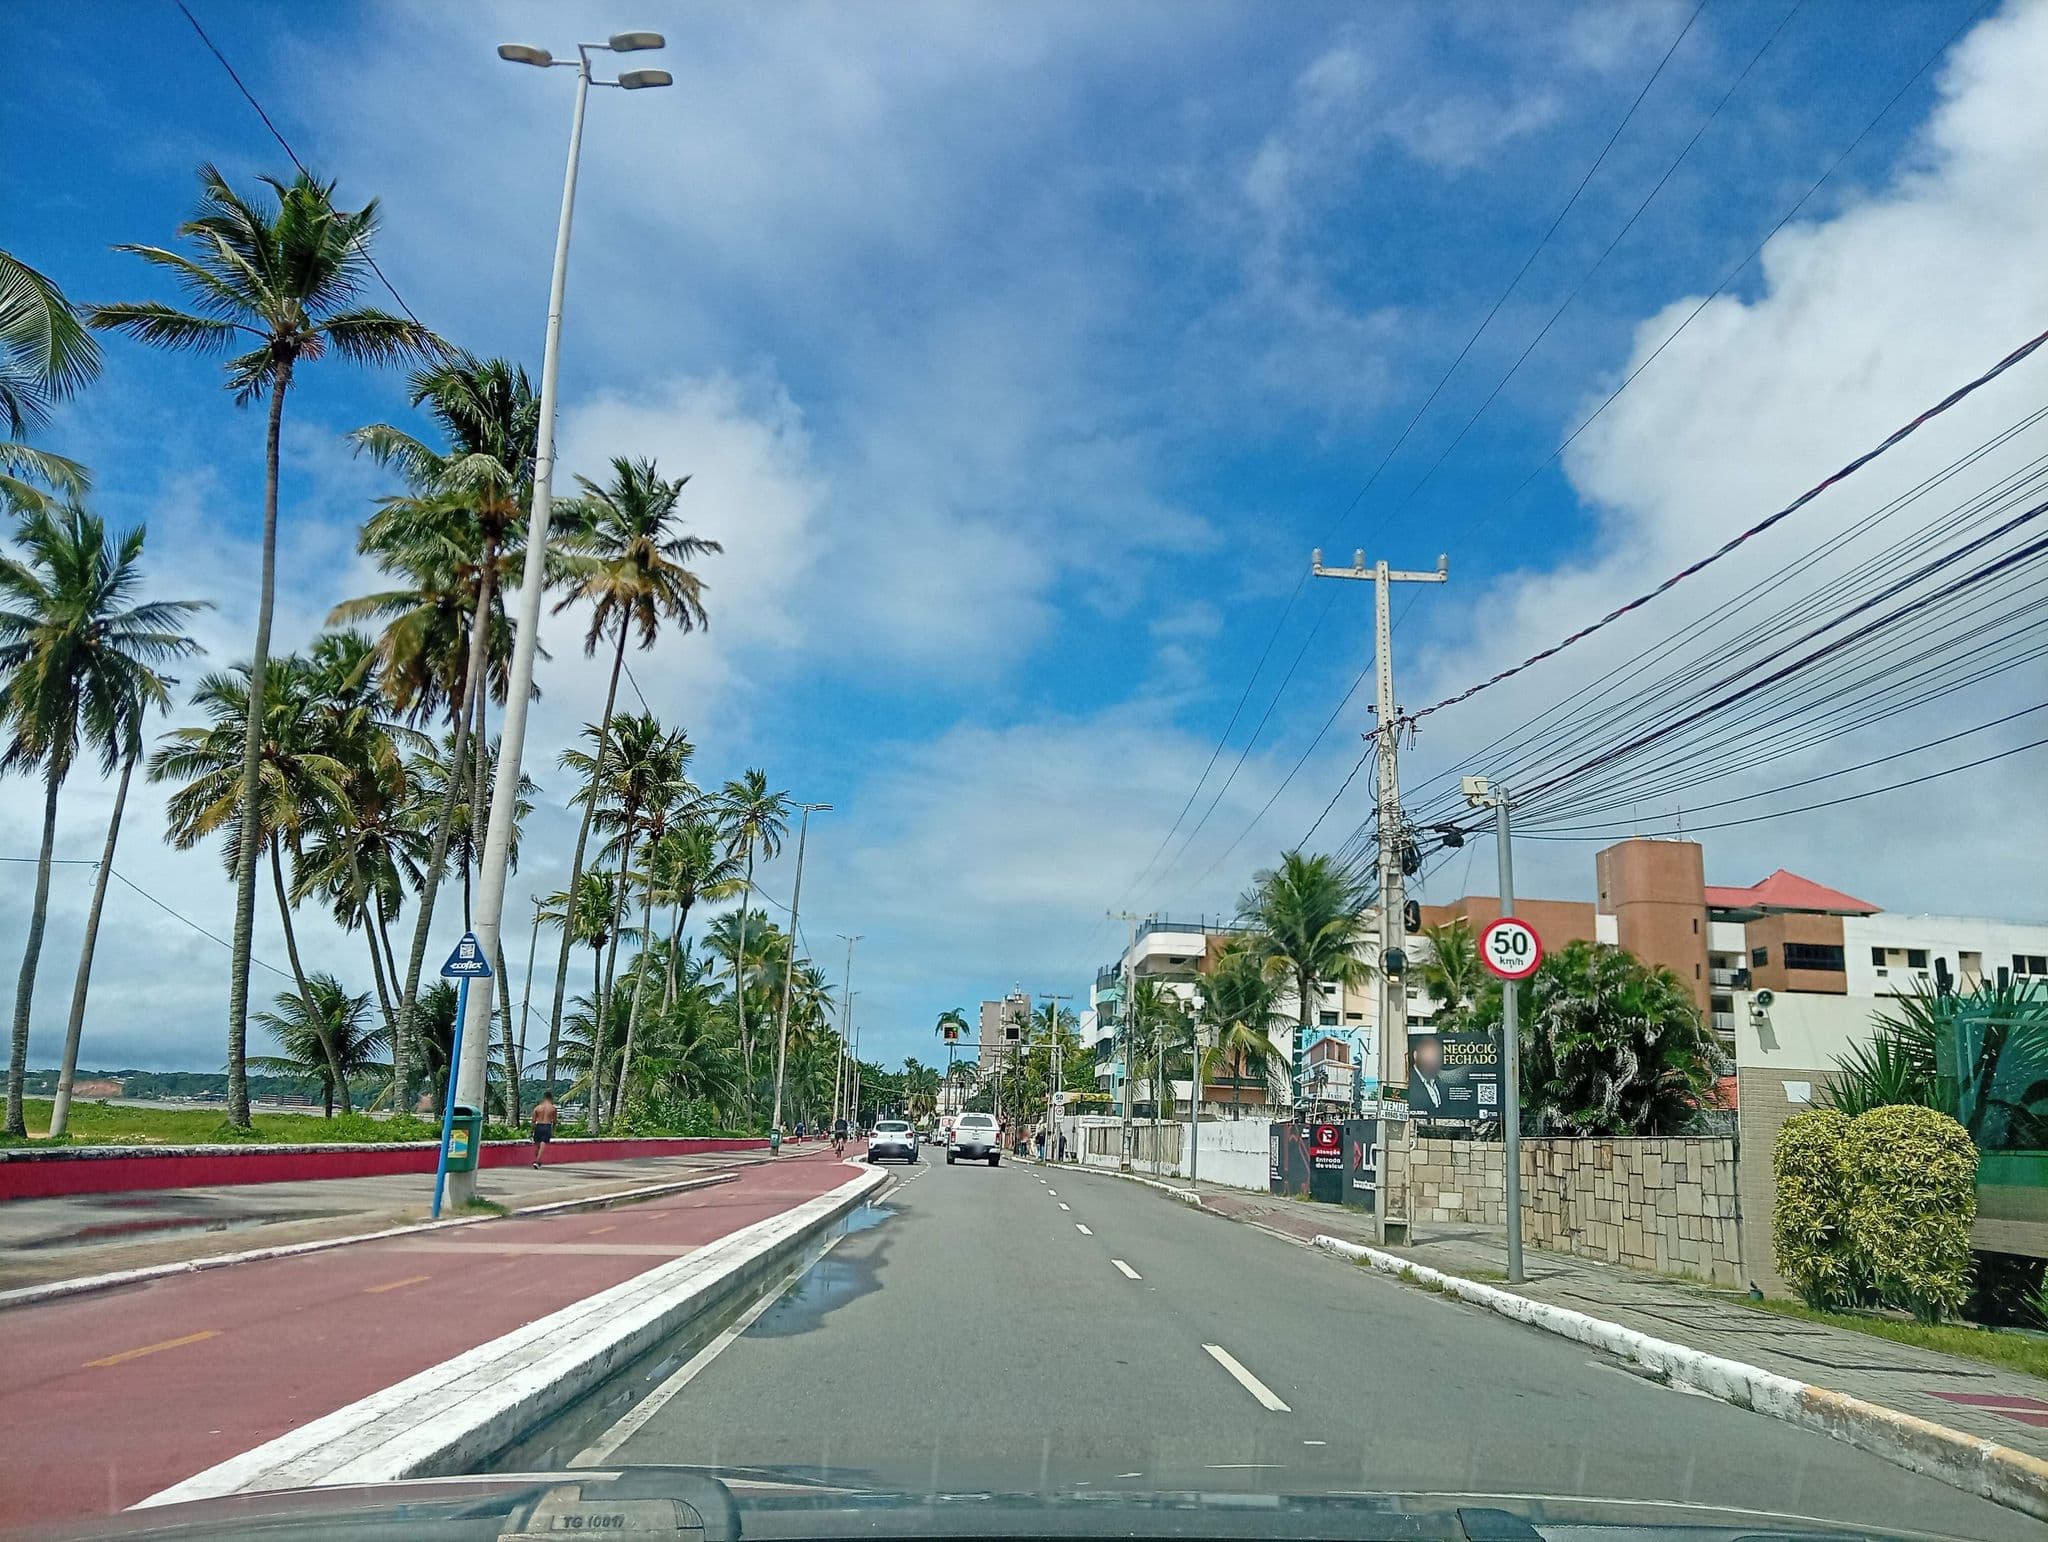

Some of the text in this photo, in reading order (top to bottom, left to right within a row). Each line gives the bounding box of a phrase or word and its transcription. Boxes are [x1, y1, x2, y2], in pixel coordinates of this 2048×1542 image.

[1494, 931, 1528, 955] 50
[449, 960, 483, 970] ecoflex
[1499, 957, 1524, 966] km/h
[1443, 1054, 1497, 1065] FECHADO
[1382, 1100, 1409, 1113] VENDE
[1316, 1148, 1341, 1156] Atenção
